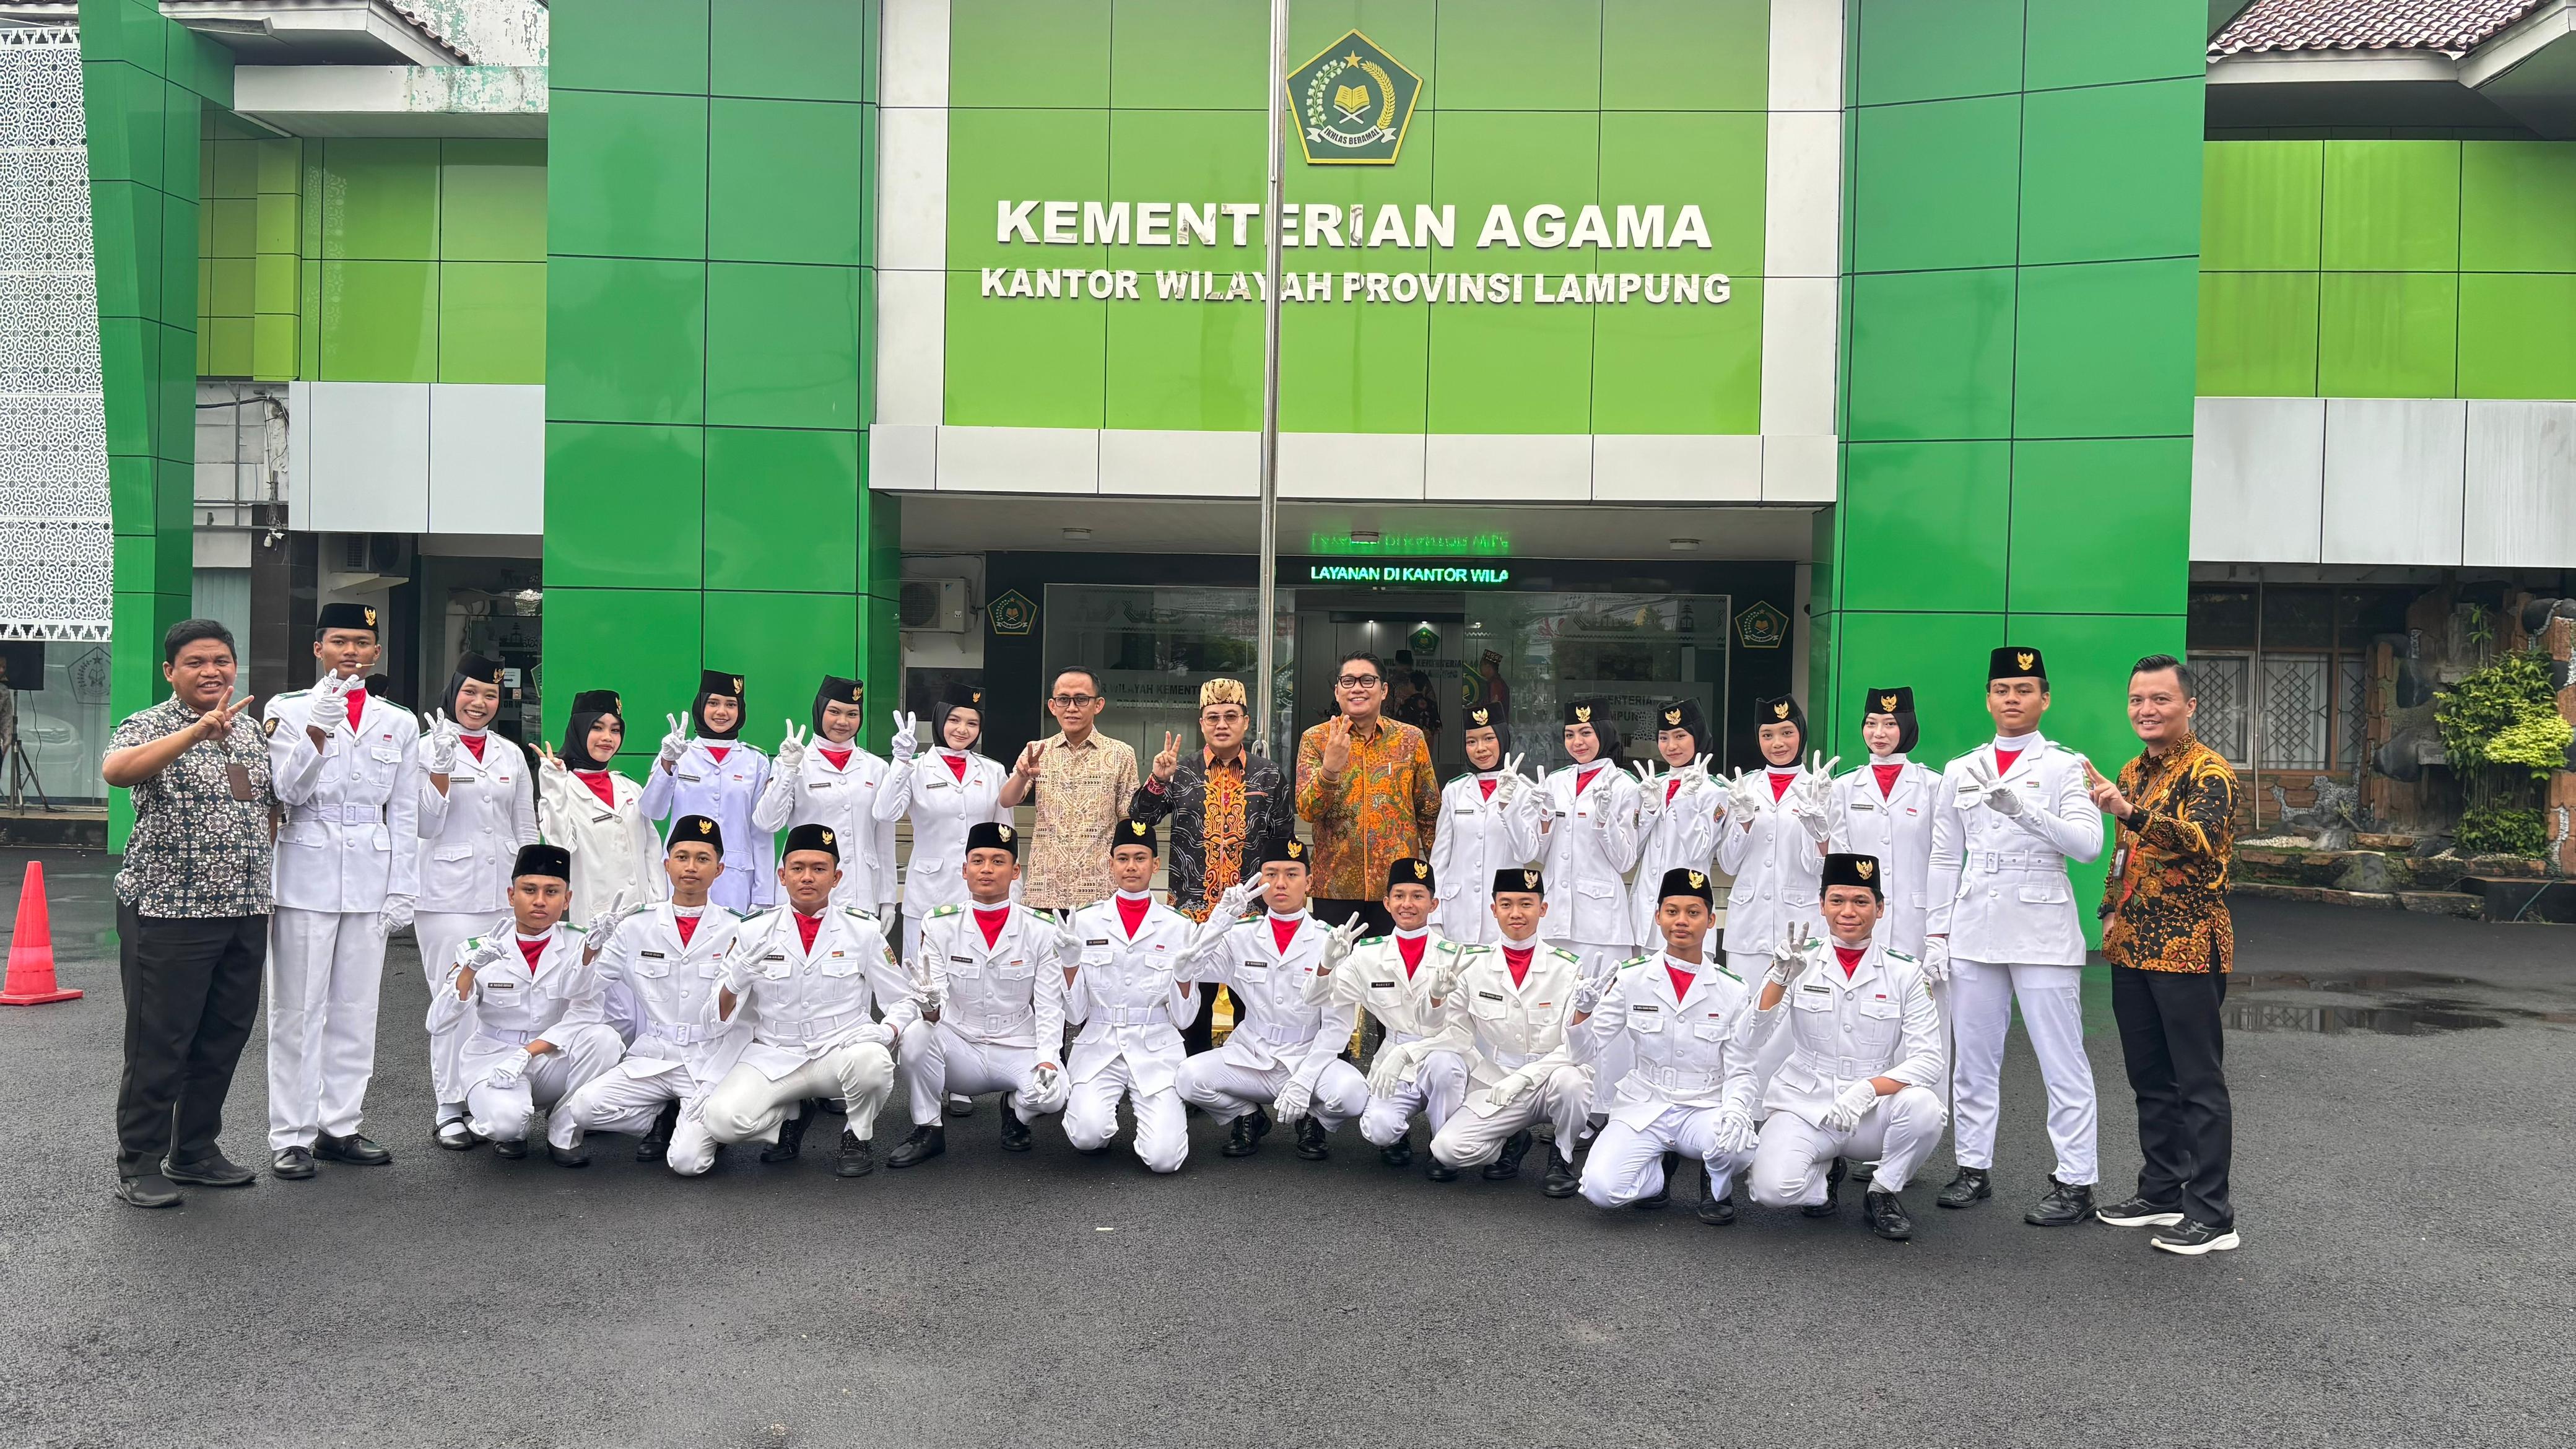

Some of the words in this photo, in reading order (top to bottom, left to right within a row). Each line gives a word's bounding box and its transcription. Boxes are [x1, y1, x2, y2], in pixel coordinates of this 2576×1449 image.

[1324, 128, 1347, 144] IKHLAS
[1349, 128, 1380, 145] BERAMAL
[997, 200, 1455, 247] KEMENTERIAN
[1476, 204, 1712, 248] AGAMA
[981, 268, 1140, 300] KANTOR
[1155, 269, 1332, 302] WILAYAH
[1342, 272, 1522, 303] PROVINSI
[1534, 273, 1731, 304] LAMPUNG
[1311, 566, 1380, 580] LAYANAN
[1384, 567, 1399, 580] DI
[1403, 568, 1468, 582] KANTOR
[1471, 568, 1508, 582] WILA
[1157, 684, 1200, 695] KEMENT
